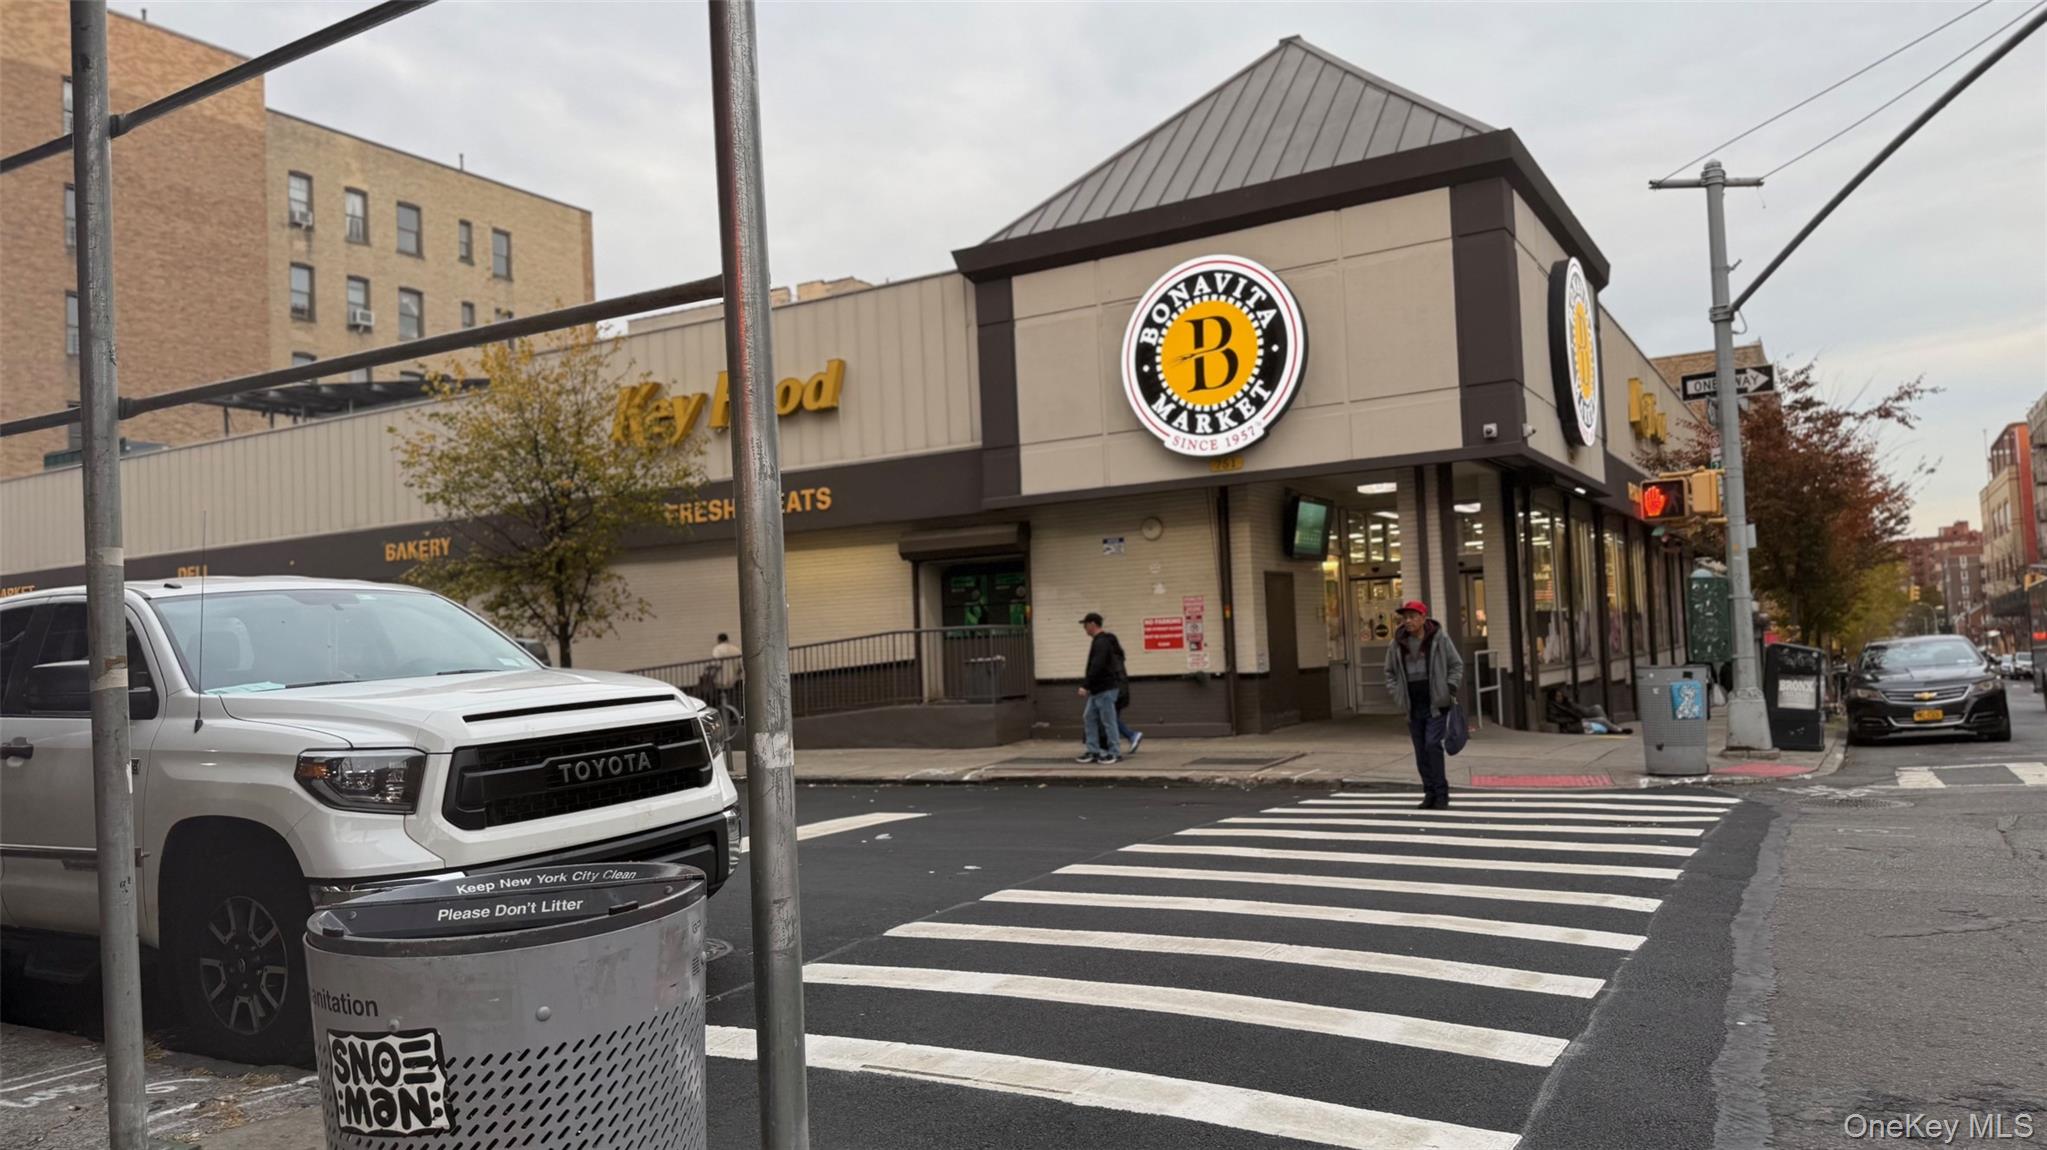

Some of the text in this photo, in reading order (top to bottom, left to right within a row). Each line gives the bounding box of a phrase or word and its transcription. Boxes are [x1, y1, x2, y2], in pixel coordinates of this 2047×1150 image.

[1140, 272, 1277, 346] BONAVITA
[1694, 379, 1718, 392] ONE
[609, 381, 708, 449] Key
[1151, 379, 1271, 433] MARKET
[1172, 425, 1256, 451] SINCE 1957
[664, 486, 832, 525] FRESH ATS
[385, 536, 452, 561] BAKERY
[558, 751, 652, 783] TOYOTA
[456, 869, 637, 895] Keep New York City Clean
[437, 898, 584, 922] Please Don't Litter
